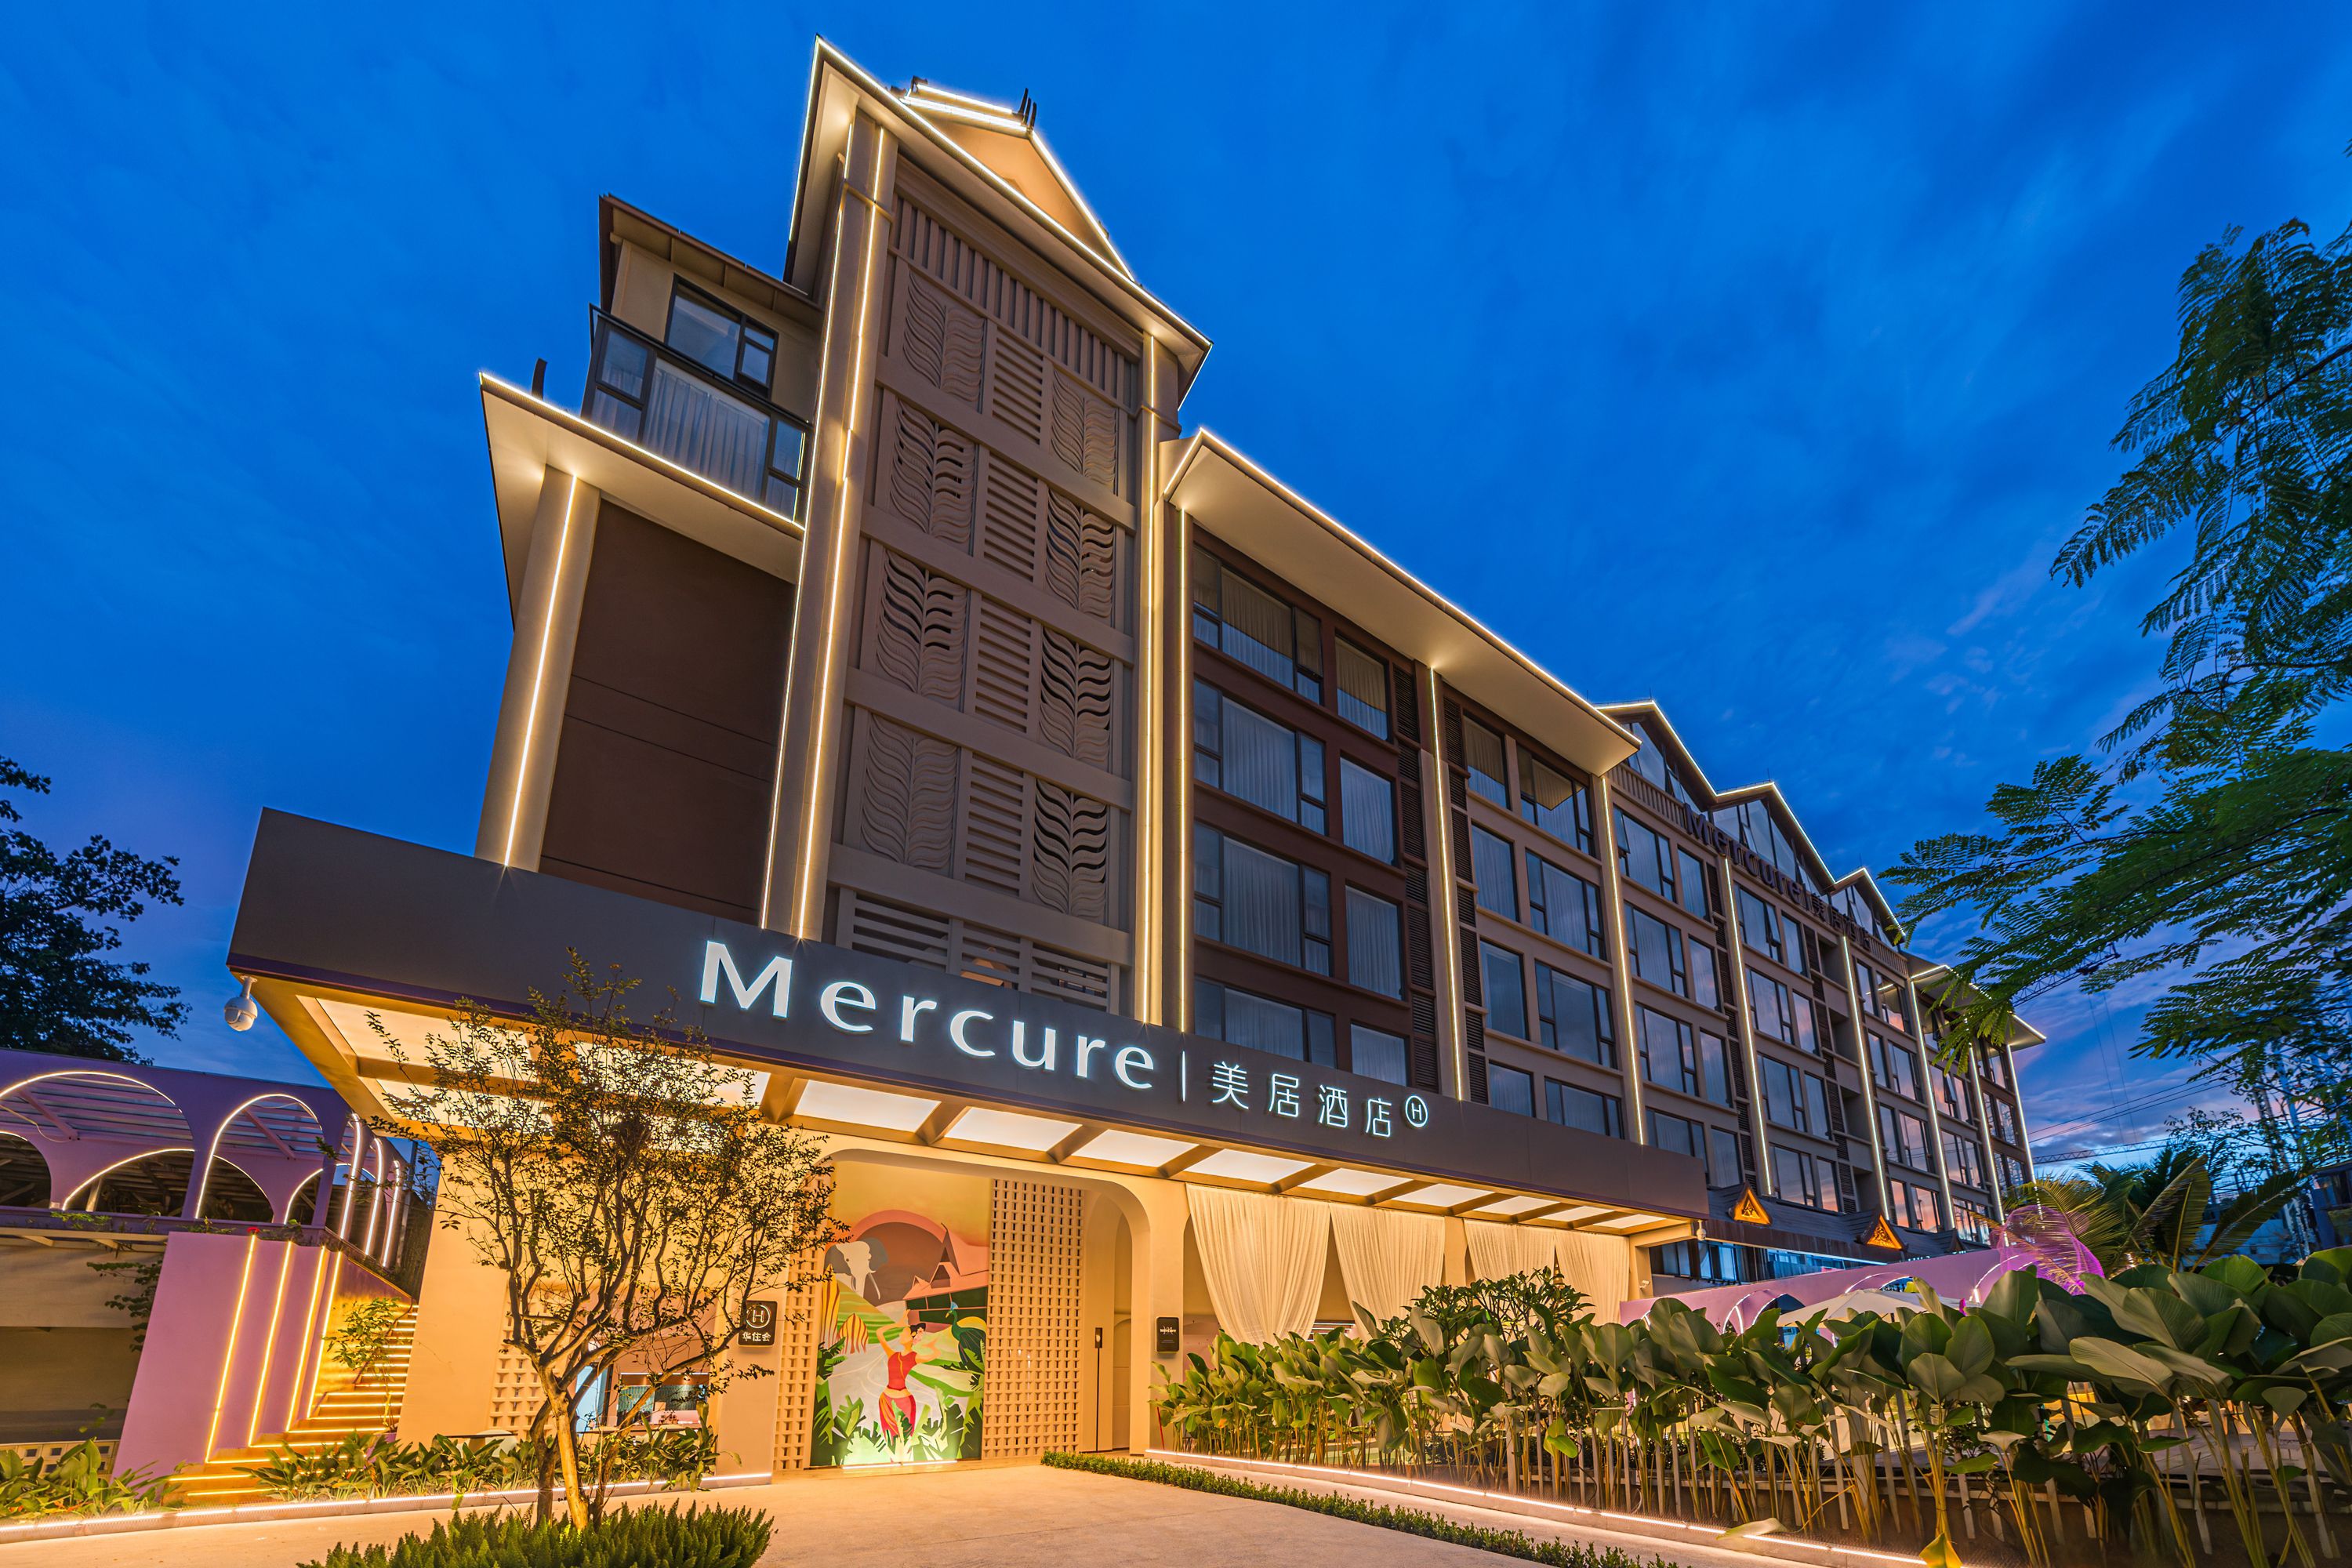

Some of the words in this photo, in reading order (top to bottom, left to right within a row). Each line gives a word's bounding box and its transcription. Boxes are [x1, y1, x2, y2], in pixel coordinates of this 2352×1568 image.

[1685, 802, 1801, 904] Mercure
[699, 940, 1156, 1091] Mercure
[1212, 1061, 1392, 1138] 美居酒店
[742, 1331, 771, 1342] 华住会
